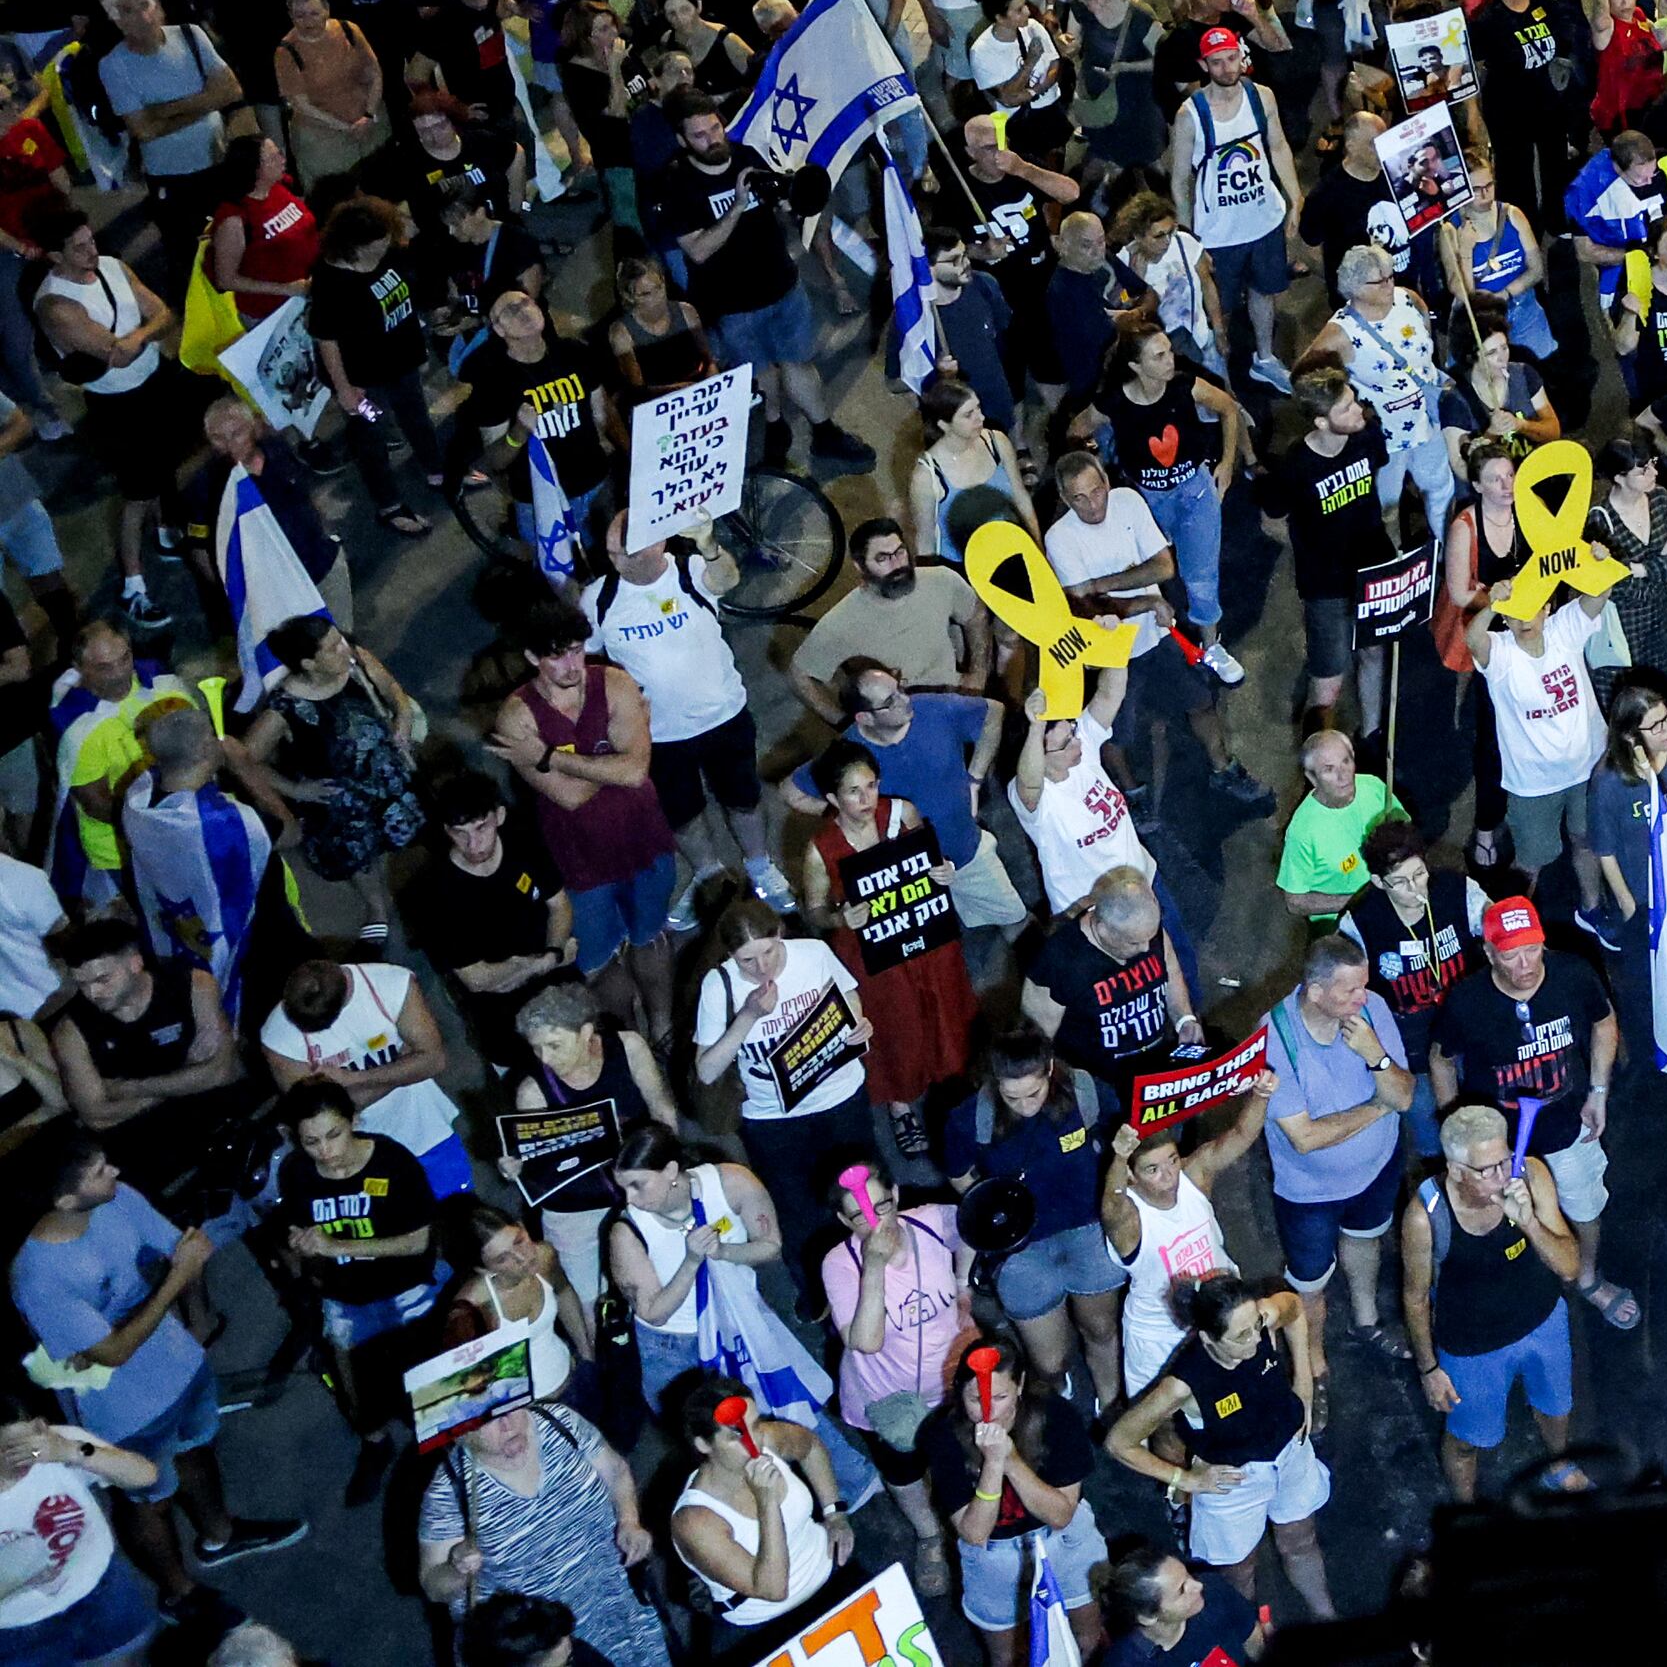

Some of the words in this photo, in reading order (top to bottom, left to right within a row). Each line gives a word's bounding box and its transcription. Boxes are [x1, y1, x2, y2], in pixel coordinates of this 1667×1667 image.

[1217, 164, 1264, 195] FCK
[1217, 186, 1264, 206] BNGVR
[523, 373, 586, 415] נחזיר
[694, 374, 734, 402] למה
[656, 397, 690, 418] הם
[669, 395, 720, 432] עדיין
[656, 419, 731, 453] בעזה?
[704, 435, 724, 450] כי
[660, 442, 699, 471] הוא
[675, 452, 710, 474] עוד
[1346, 458, 1370, 482] אתם
[702, 462, 728, 484] לא
[1356, 476, 1372, 496] הם
[651, 477, 699, 508] הלך
[1540, 546, 1580, 578] NOW.
[1368, 570, 1414, 600] שכחנו
[1358, 582, 1415, 620] החטופים
[668, 612, 690, 631] יש
[1048, 626, 1092, 668] NOW.
[902, 851, 934, 876] בני
[858, 864, 900, 897] אדם
[902, 876, 932, 904] הם
[871, 890, 897, 917] לא
[914, 893, 950, 926] נזק
[863, 912, 911, 943] אגבי
[1093, 954, 1161, 1007] עוצרים
[1100, 1009, 1165, 1048] חוזרים
[1143, 1069, 1213, 1102] BRING
[1214, 1036, 1267, 1084] THEM
[1141, 1101, 1179, 1124] ALL
[1183, 1075, 1242, 1114] BACK
[314, 1197, 337, 1222] הם
[339, 1190, 372, 1215] למה
